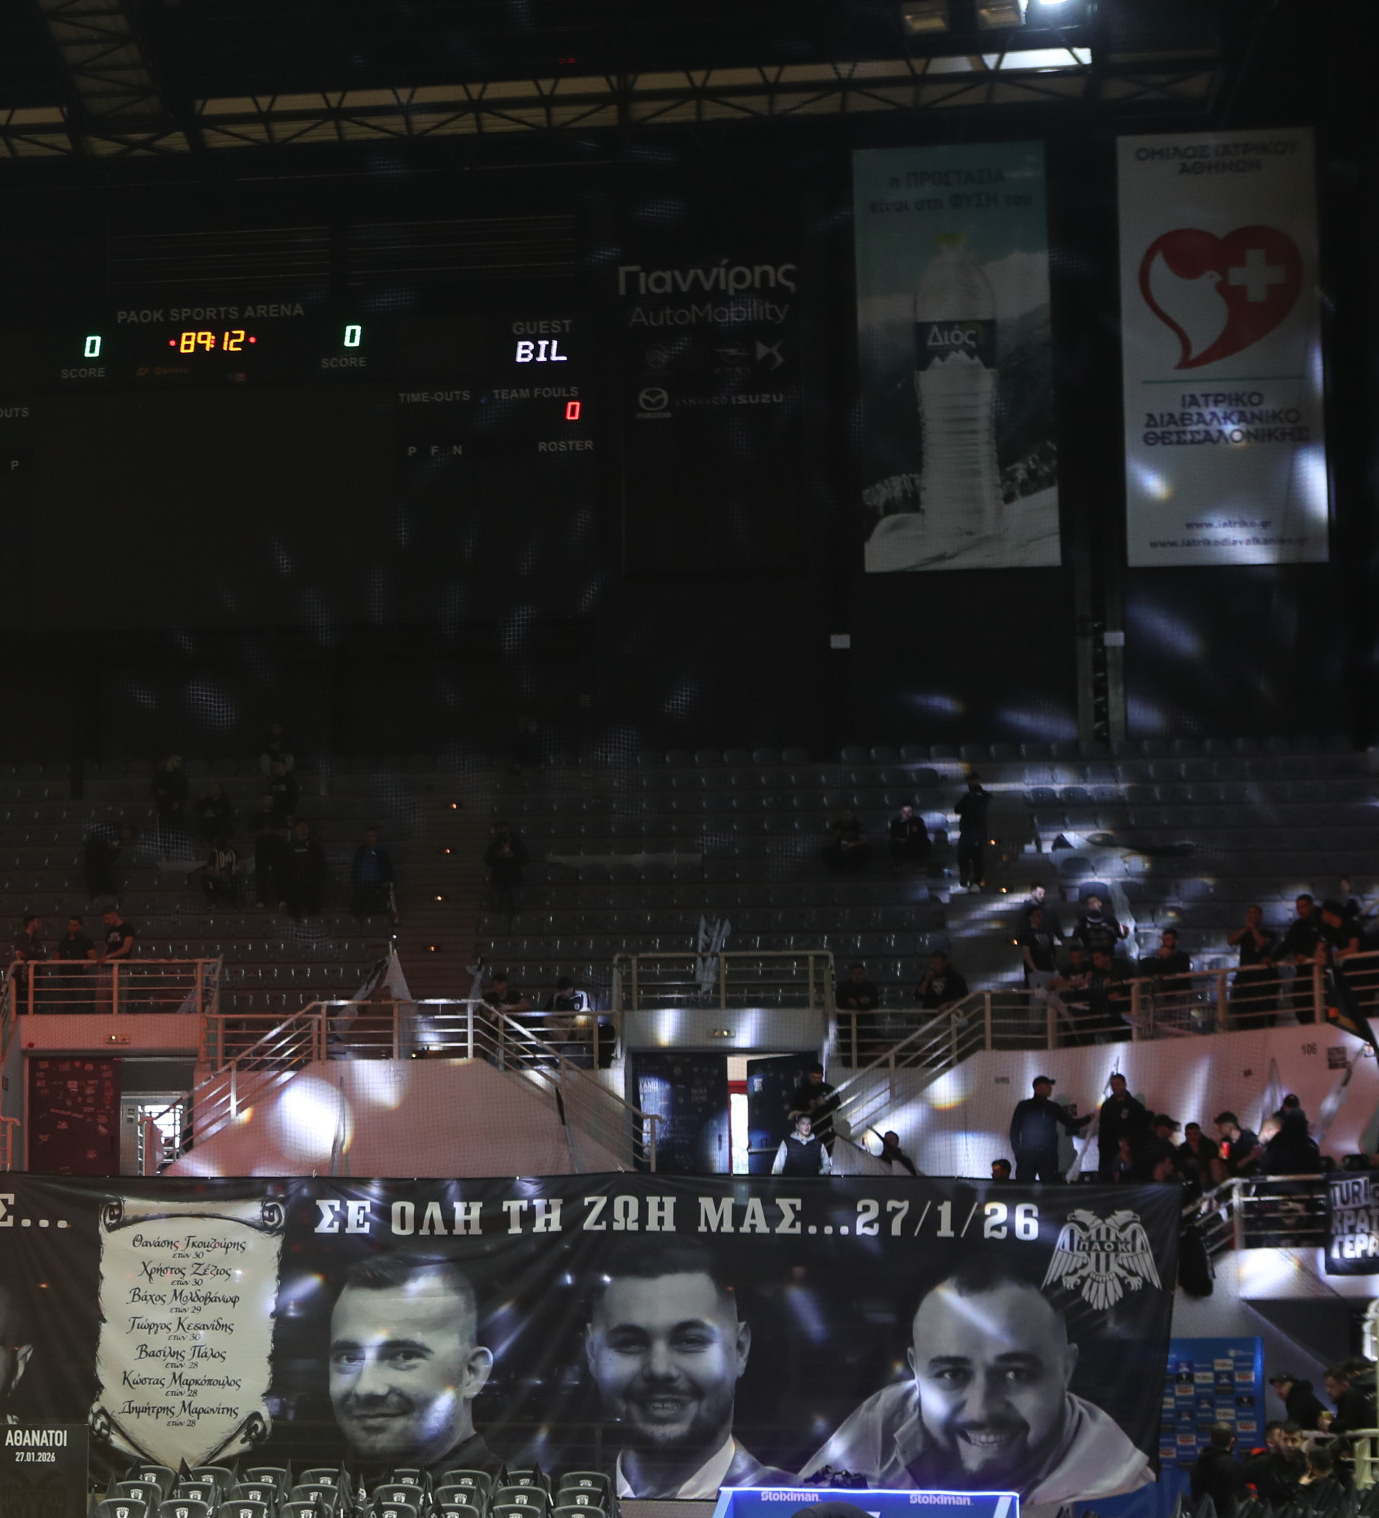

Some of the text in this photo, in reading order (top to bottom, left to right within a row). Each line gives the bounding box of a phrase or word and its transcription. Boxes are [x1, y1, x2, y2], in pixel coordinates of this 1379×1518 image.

[906, 169, 1005, 187] ΠΡΟΣΤΑΣΙΑ
[949, 192, 998, 208] ΦΥΣΗ
[116, 303, 306, 325] PAOK SPORTS ARENA
[628, 298, 790, 328] AutoMobility
[512, 320, 573, 335] GUEST
[179, 330, 246, 353] 89:12
[344, 324, 362, 348] 0
[927, 324, 977, 348] Διός
[84, 335, 102, 358] 0
[515, 340, 568, 363] BIL
[321, 357, 367, 369] SCORE
[60, 367, 106, 379] SCORE
[399, 390, 471, 403] TIME-OUTS
[493, 386, 579, 400] TEAM FOULS
[732, 393, 784, 405] ISUZU
[1181, 391, 1265, 408] ΙΑΤΡΙΚΟ
[565, 400, 581, 420] 0
[1145, 409, 1301, 428] ΔΙΑΒΑΛΚΑΝΙΚΟ
[1143, 427, 1310, 446] ΘΕΣΣΑΛΟΝΙΚΗΣ
[408, 444, 463, 456] P F N
[538, 440, 594, 453] ROSTER
[11, 460, 20, 470] P
[314, 1199, 371, 1233] ΣΕ
[391, 1200, 483, 1236] ΟΛΗ
[503, 1198, 564, 1234] ΤΗ
[583, 1195, 677, 1233] ΖΩΗ
[132, 1234, 180, 1250] Θανάσης
[1079, 1241, 1131, 1253] ΠΑΟΚ
[138, 1261, 232, 1284] Χρήστος Ζέζιος
[192, 1278, 204, 1286] 30
[126, 1287, 240, 1309] Βάχος Μολδοβάνωφ
[170, 1306, 202, 1314] ετών 29
[126, 1316, 234, 1334] Γιώργος Κεσανίδης
[189, 1333, 201, 1341] 30
[134, 1344, 227, 1362] Βασίλης Πάλος
[188, 1361, 199, 1369] 28
[122, 1370, 242, 1391] Κώστας Μαρκόπουλος
[165, 1389, 198, 1397] ετών 28
[118, 1400, 239, 1419] Δημήτρης Μαρωνίτης
[167, 1419, 197, 1427] ετών 28
[5, 1429, 68, 1447] ΑΘΑΝΑΤΟΙ
[15, 1451, 56, 1463] 27.01.2026
[761, 1490, 820, 1503] Stoiximan
[910, 1493, 971, 1506] Stoiximan
